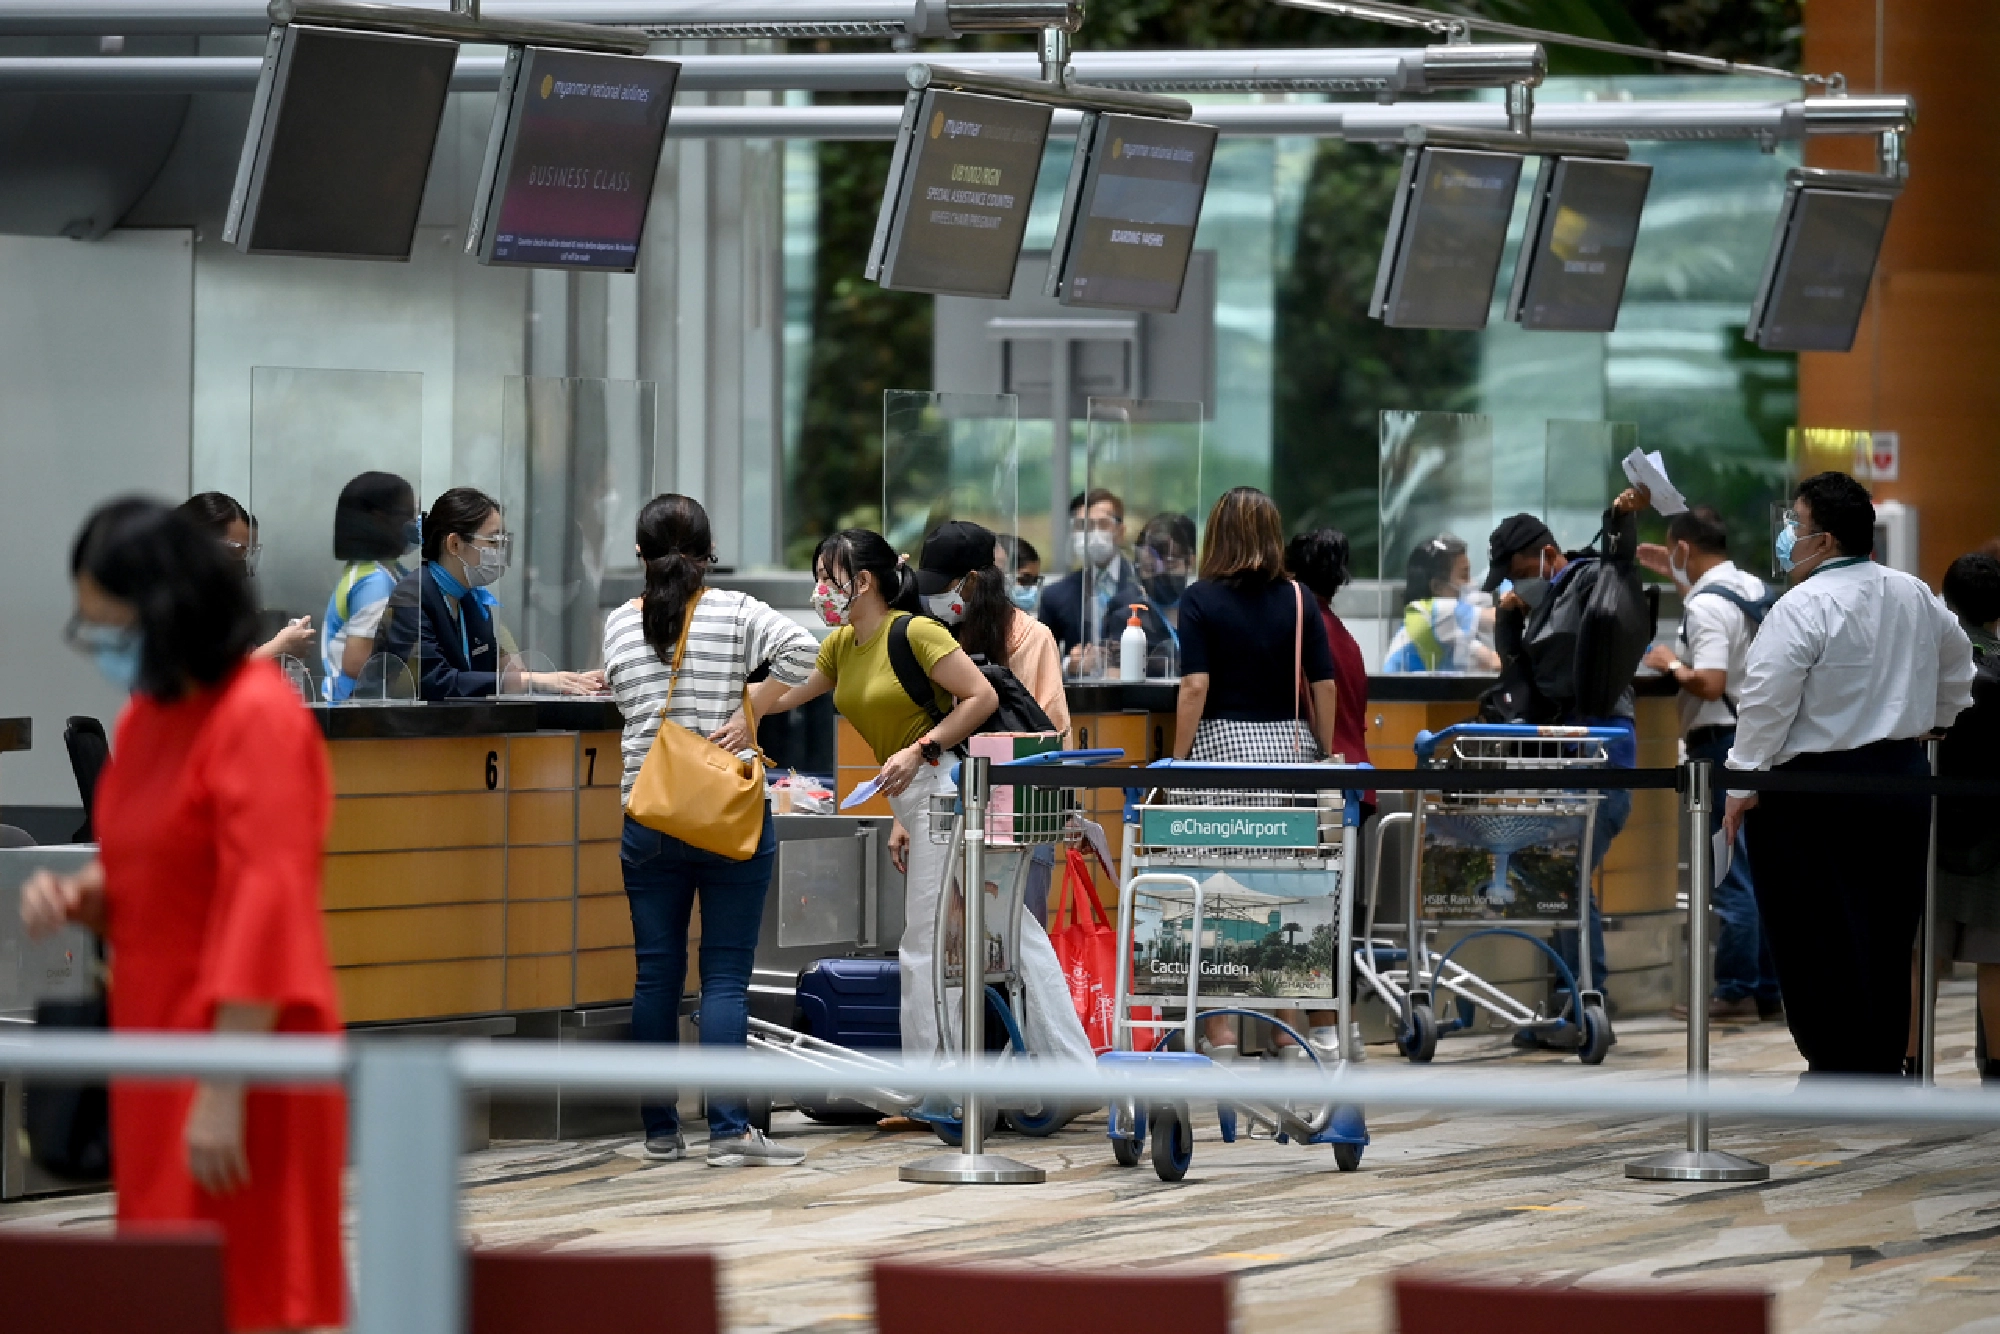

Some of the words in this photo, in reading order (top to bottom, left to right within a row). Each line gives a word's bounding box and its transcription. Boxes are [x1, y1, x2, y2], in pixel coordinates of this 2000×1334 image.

[553, 80, 590, 99] myanmar
[590, 82, 621, 99] national
[621, 84, 650, 102] airlines
[943, 119, 983, 139] myanmar
[528, 165, 590, 188] BUSINESS
[593, 169, 631, 191] CLASS
[485, 750, 498, 790] 6
[584, 747, 597, 786] 7
[1170, 818, 1288, 838] @ChangiAirport
[1422, 894, 1448, 905] HSBC
[1450, 894, 1471, 905] Rain
[1150, 959, 1190, 974] Cactu
[1200, 960, 1249, 976] Garden
